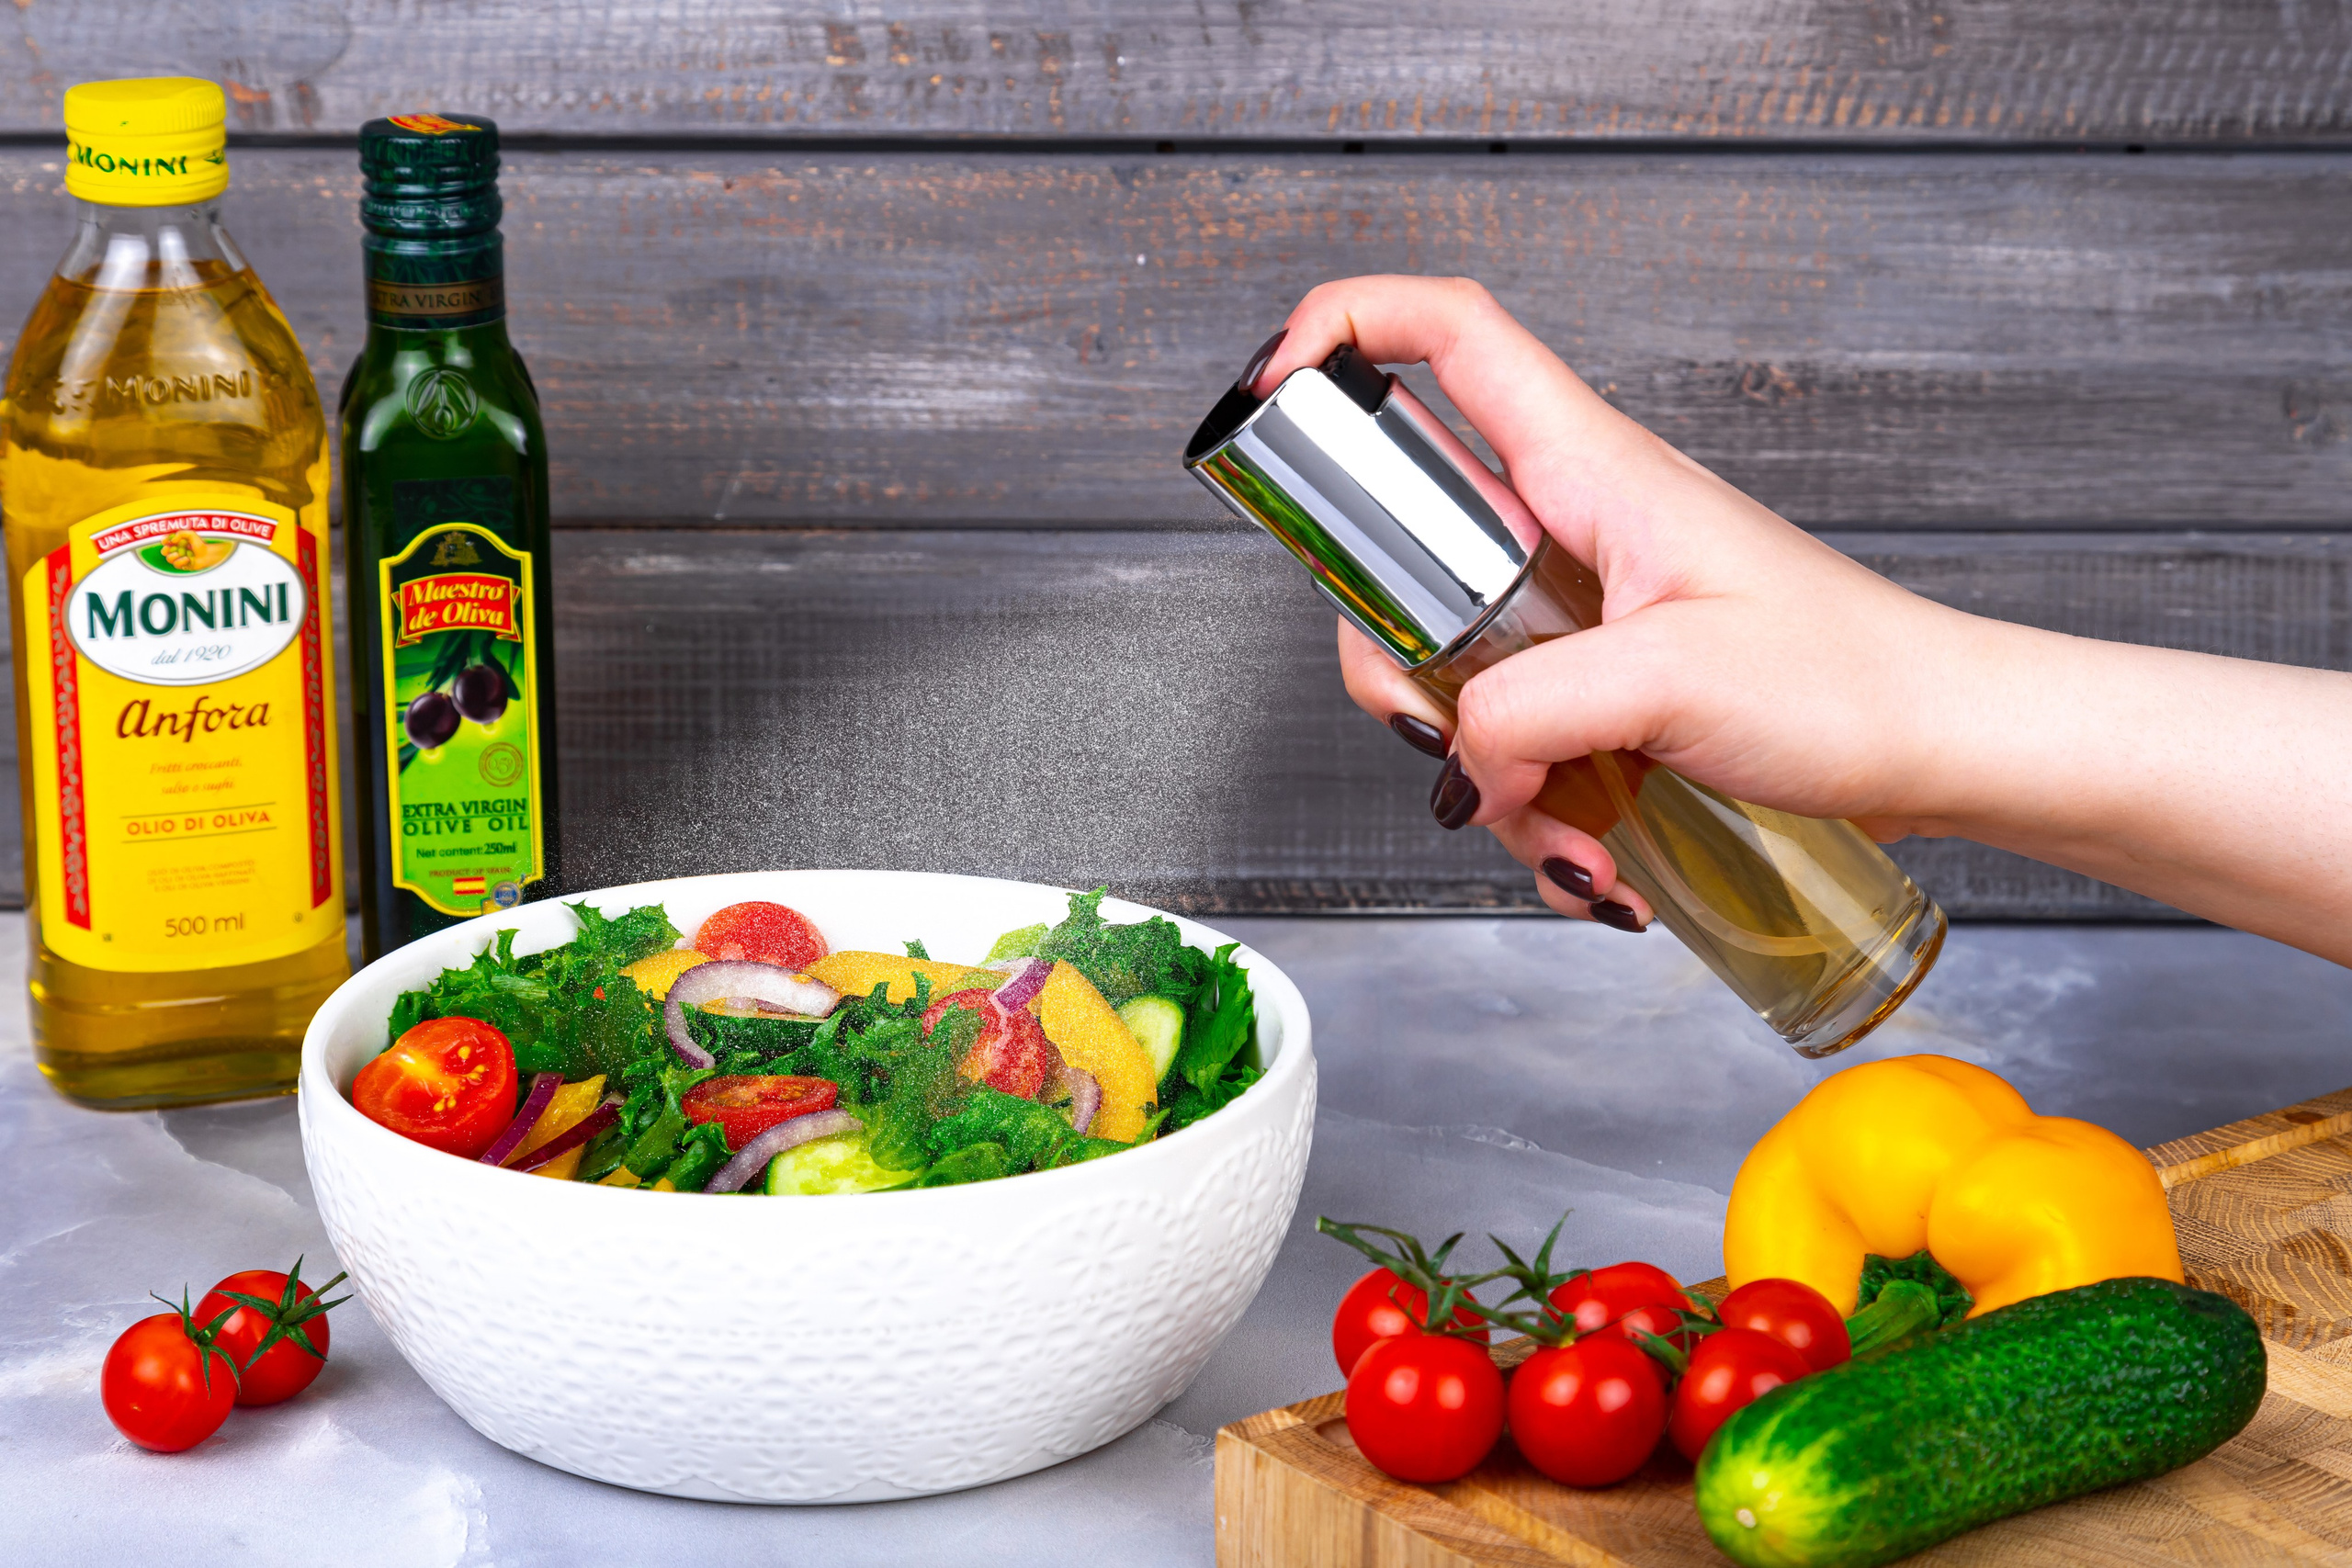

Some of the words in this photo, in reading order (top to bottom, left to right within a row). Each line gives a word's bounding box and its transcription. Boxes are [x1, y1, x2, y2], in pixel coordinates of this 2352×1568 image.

[74, 142, 187, 176] MONINI
[414, 289, 481, 309] VIRGIN
[105, 370, 251, 405] MONINI
[97, 532, 134, 549] UNA
[133, 516, 208, 537] SPREMUTA
[211, 517, 228, 530] DI
[231, 519, 272, 536] OLIVE
[408, 581, 506, 606] Maestro
[85, 581, 290, 639] MONINI
[409, 606, 438, 630] de
[442, 602, 504, 626] Oliva
[151, 649, 182, 665] dal
[184, 645, 231, 662] 1920
[116, 695, 271, 743] Anfora
[401, 802, 457, 818] EXTRA
[460, 798, 526, 815] VIRGIN
[127, 819, 175, 835] OLIO
[185, 817, 202, 830] DI
[212, 811, 270, 828] OLIVA
[402, 819, 471, 836] OLIVE
[488, 817, 528, 831] OIL
[416, 848, 435, 858] Net
[429, 868, 470, 877] PRODUCT
[164, 916, 206, 938] 500
[214, 911, 243, 932] ml
